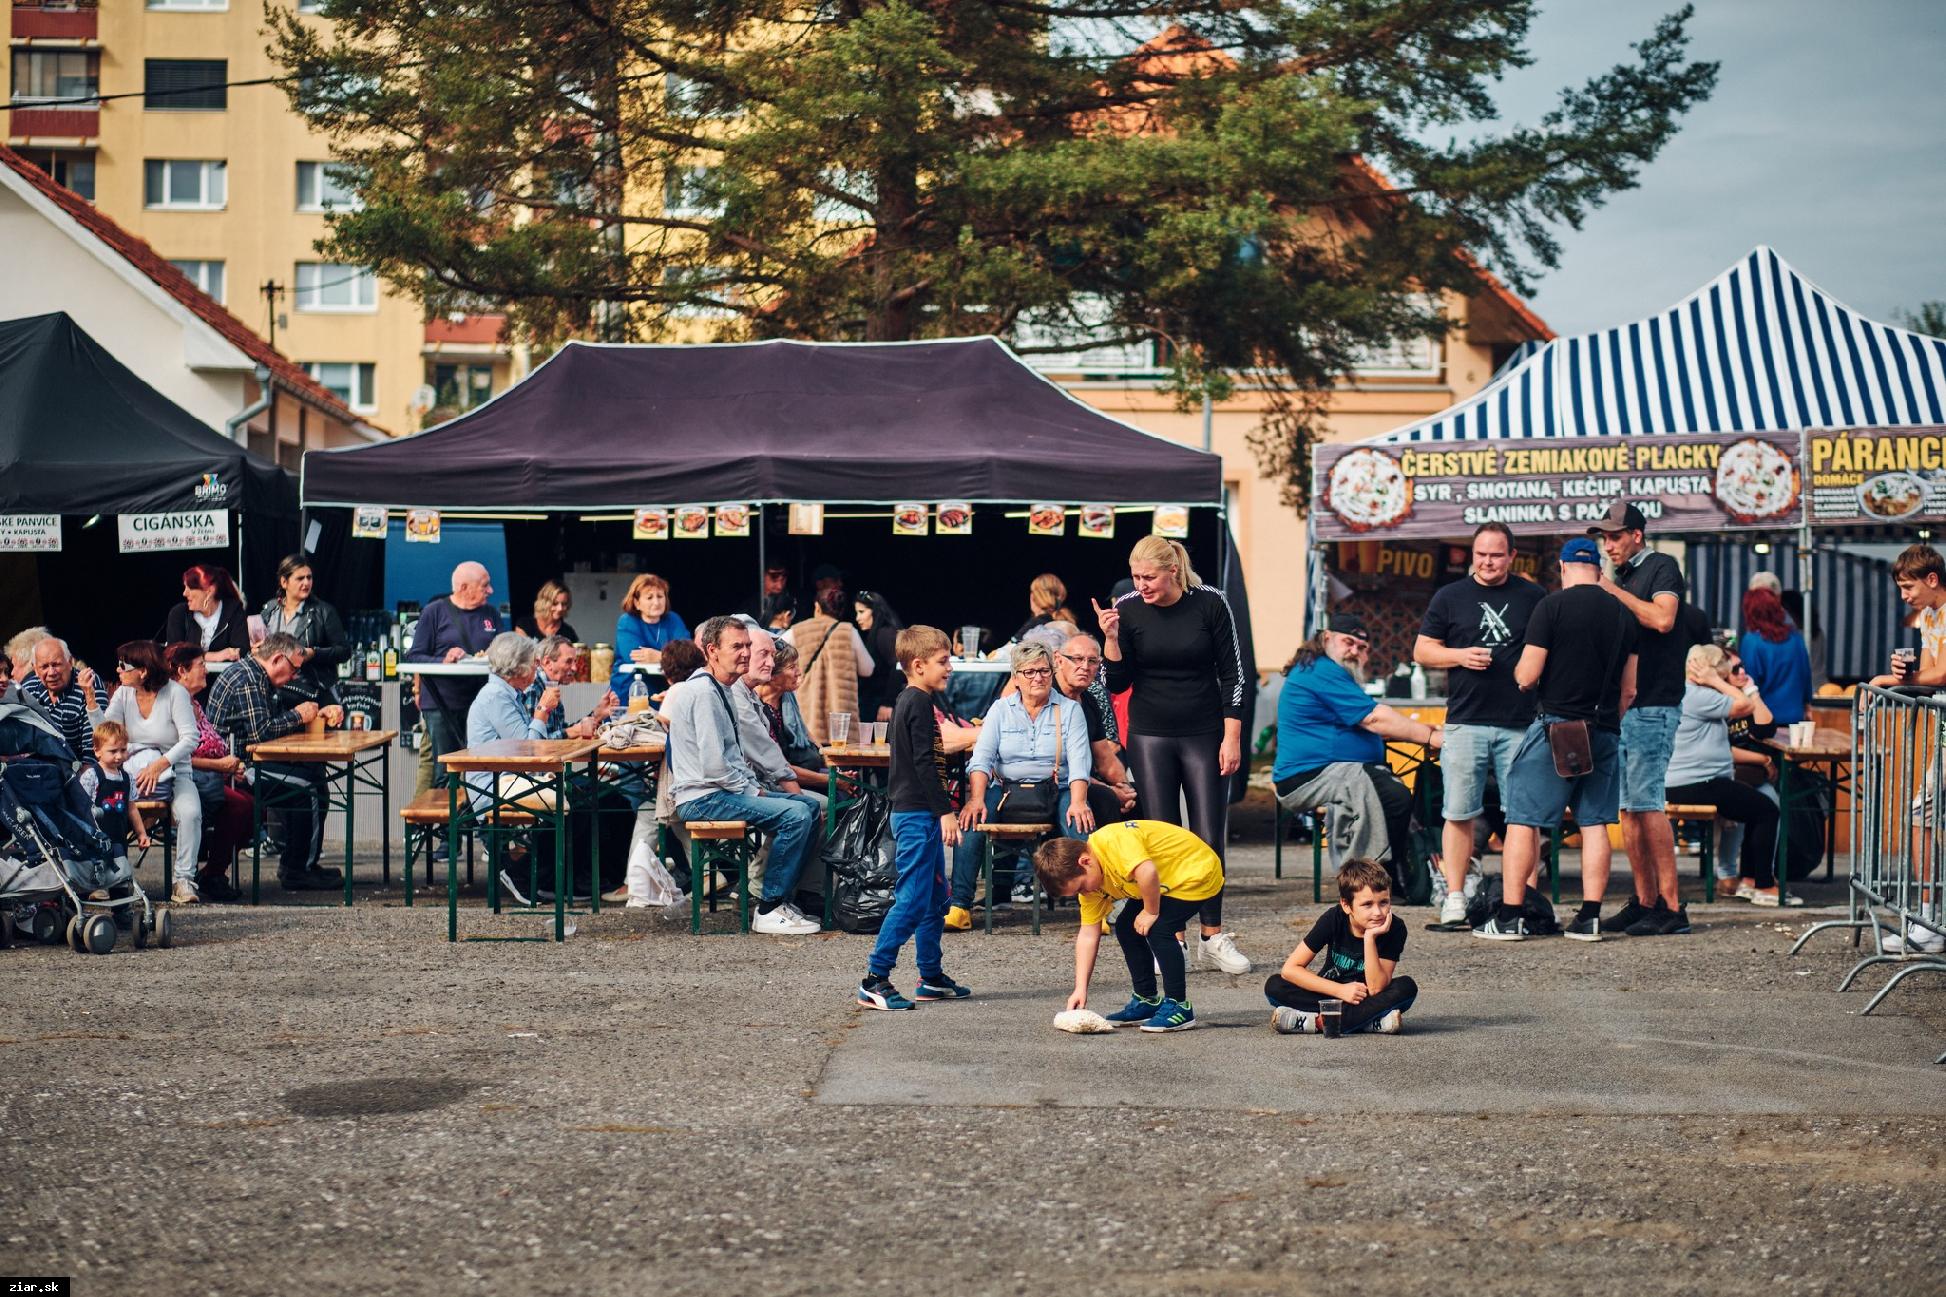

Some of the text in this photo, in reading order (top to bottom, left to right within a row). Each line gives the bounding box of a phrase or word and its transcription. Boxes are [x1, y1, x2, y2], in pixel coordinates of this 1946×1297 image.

[1402, 442, 1720, 477] ČERSTVÉ ZEMIAKOVÉ PLACKY
[1812, 431, 1946, 471] PÁRANC
[1413, 484, 1451, 501] SYR
[1466, 481, 1557, 500] SMOTANA,
[1563, 476, 1625, 497] KEČUP,
[1630, 476, 1711, 495] KAPUSTA
[17, 517, 57, 526] PANVICE
[133, 513, 215, 531] CIGÁNSKA
[1464, 498, 1662, 523] SLANINKA S PAŽOU
[1377, 549, 1434, 579] PIVO
